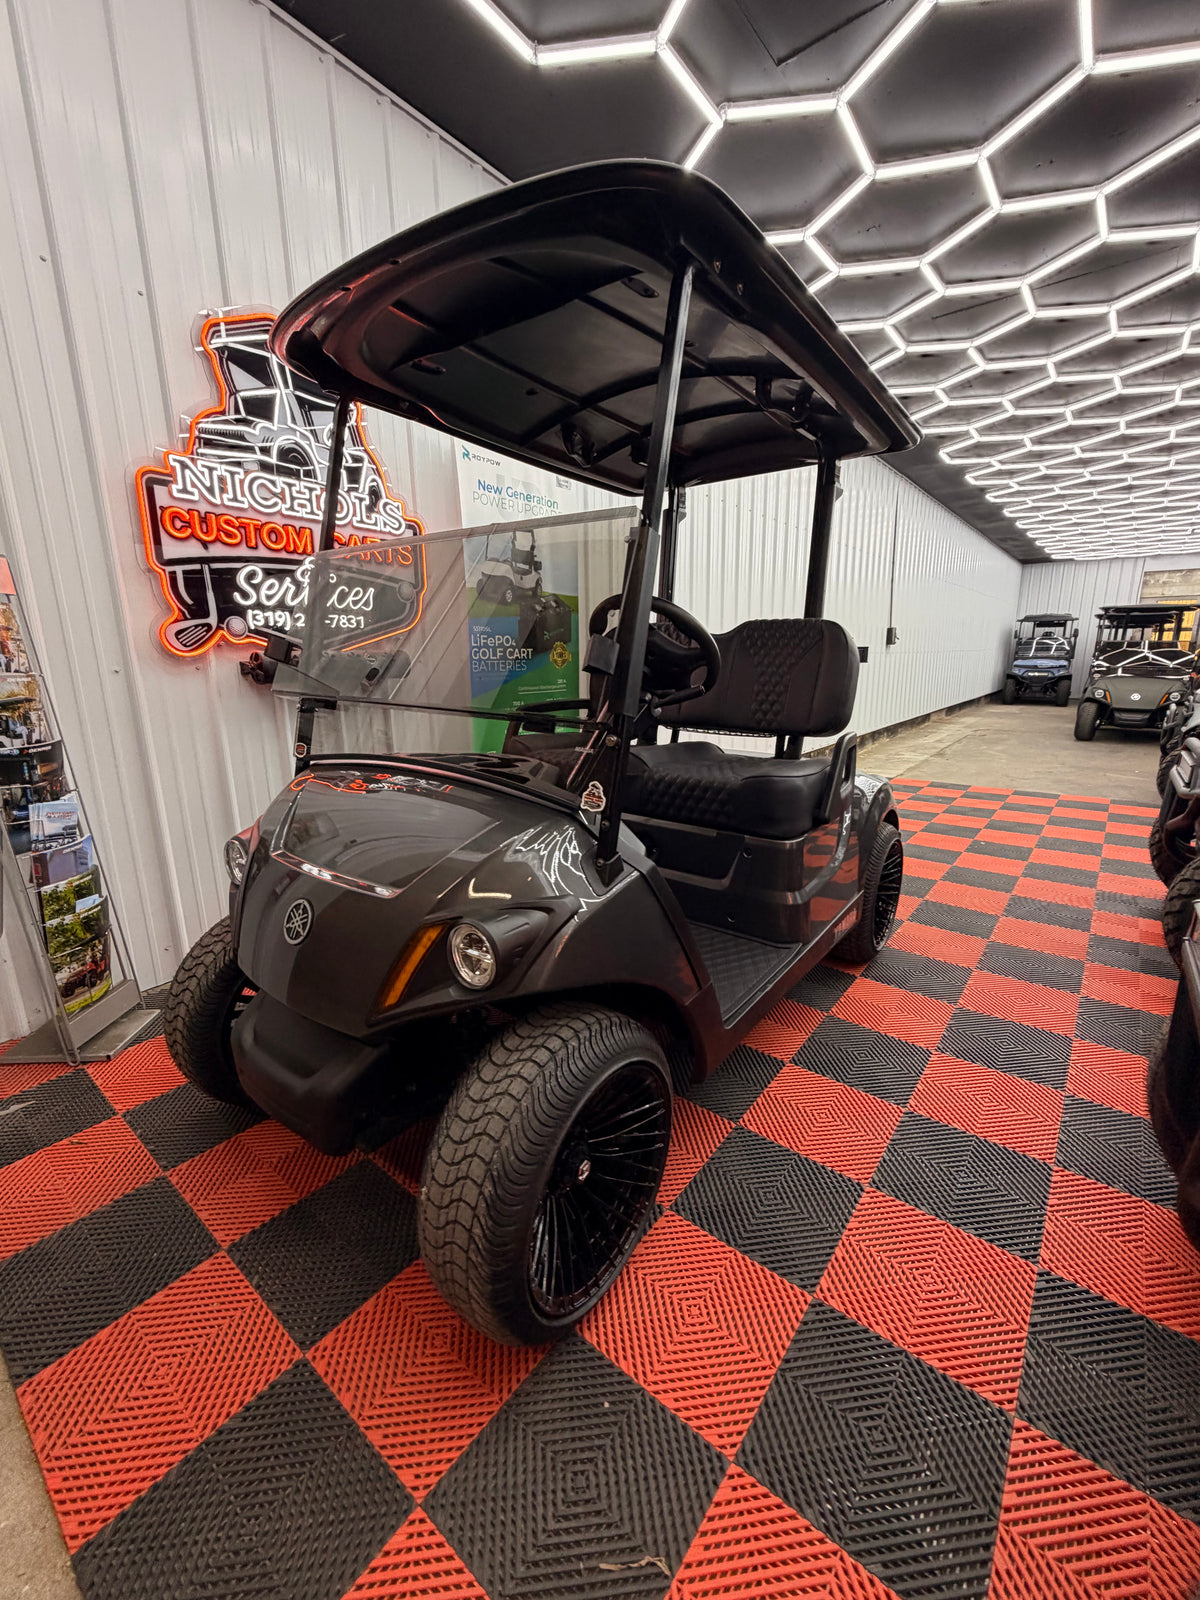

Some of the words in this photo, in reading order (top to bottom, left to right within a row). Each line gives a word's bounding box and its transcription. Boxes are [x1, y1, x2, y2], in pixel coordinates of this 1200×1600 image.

[471, 453, 501, 467] ROYPOW
[169, 454, 406, 534] NICHOLS
[473, 491, 515, 510] POWER
[478, 479, 503, 495] New
[506, 486, 559, 510] Generation
[161, 506, 313, 555] CUSTOM
[246, 609, 291, 631] (319)
[295, 613, 365, 629] 2-7831
[471, 648, 504, 660] GOLF
[506, 648, 533, 660] CART
[472, 660, 527, 672] BATTERIES
